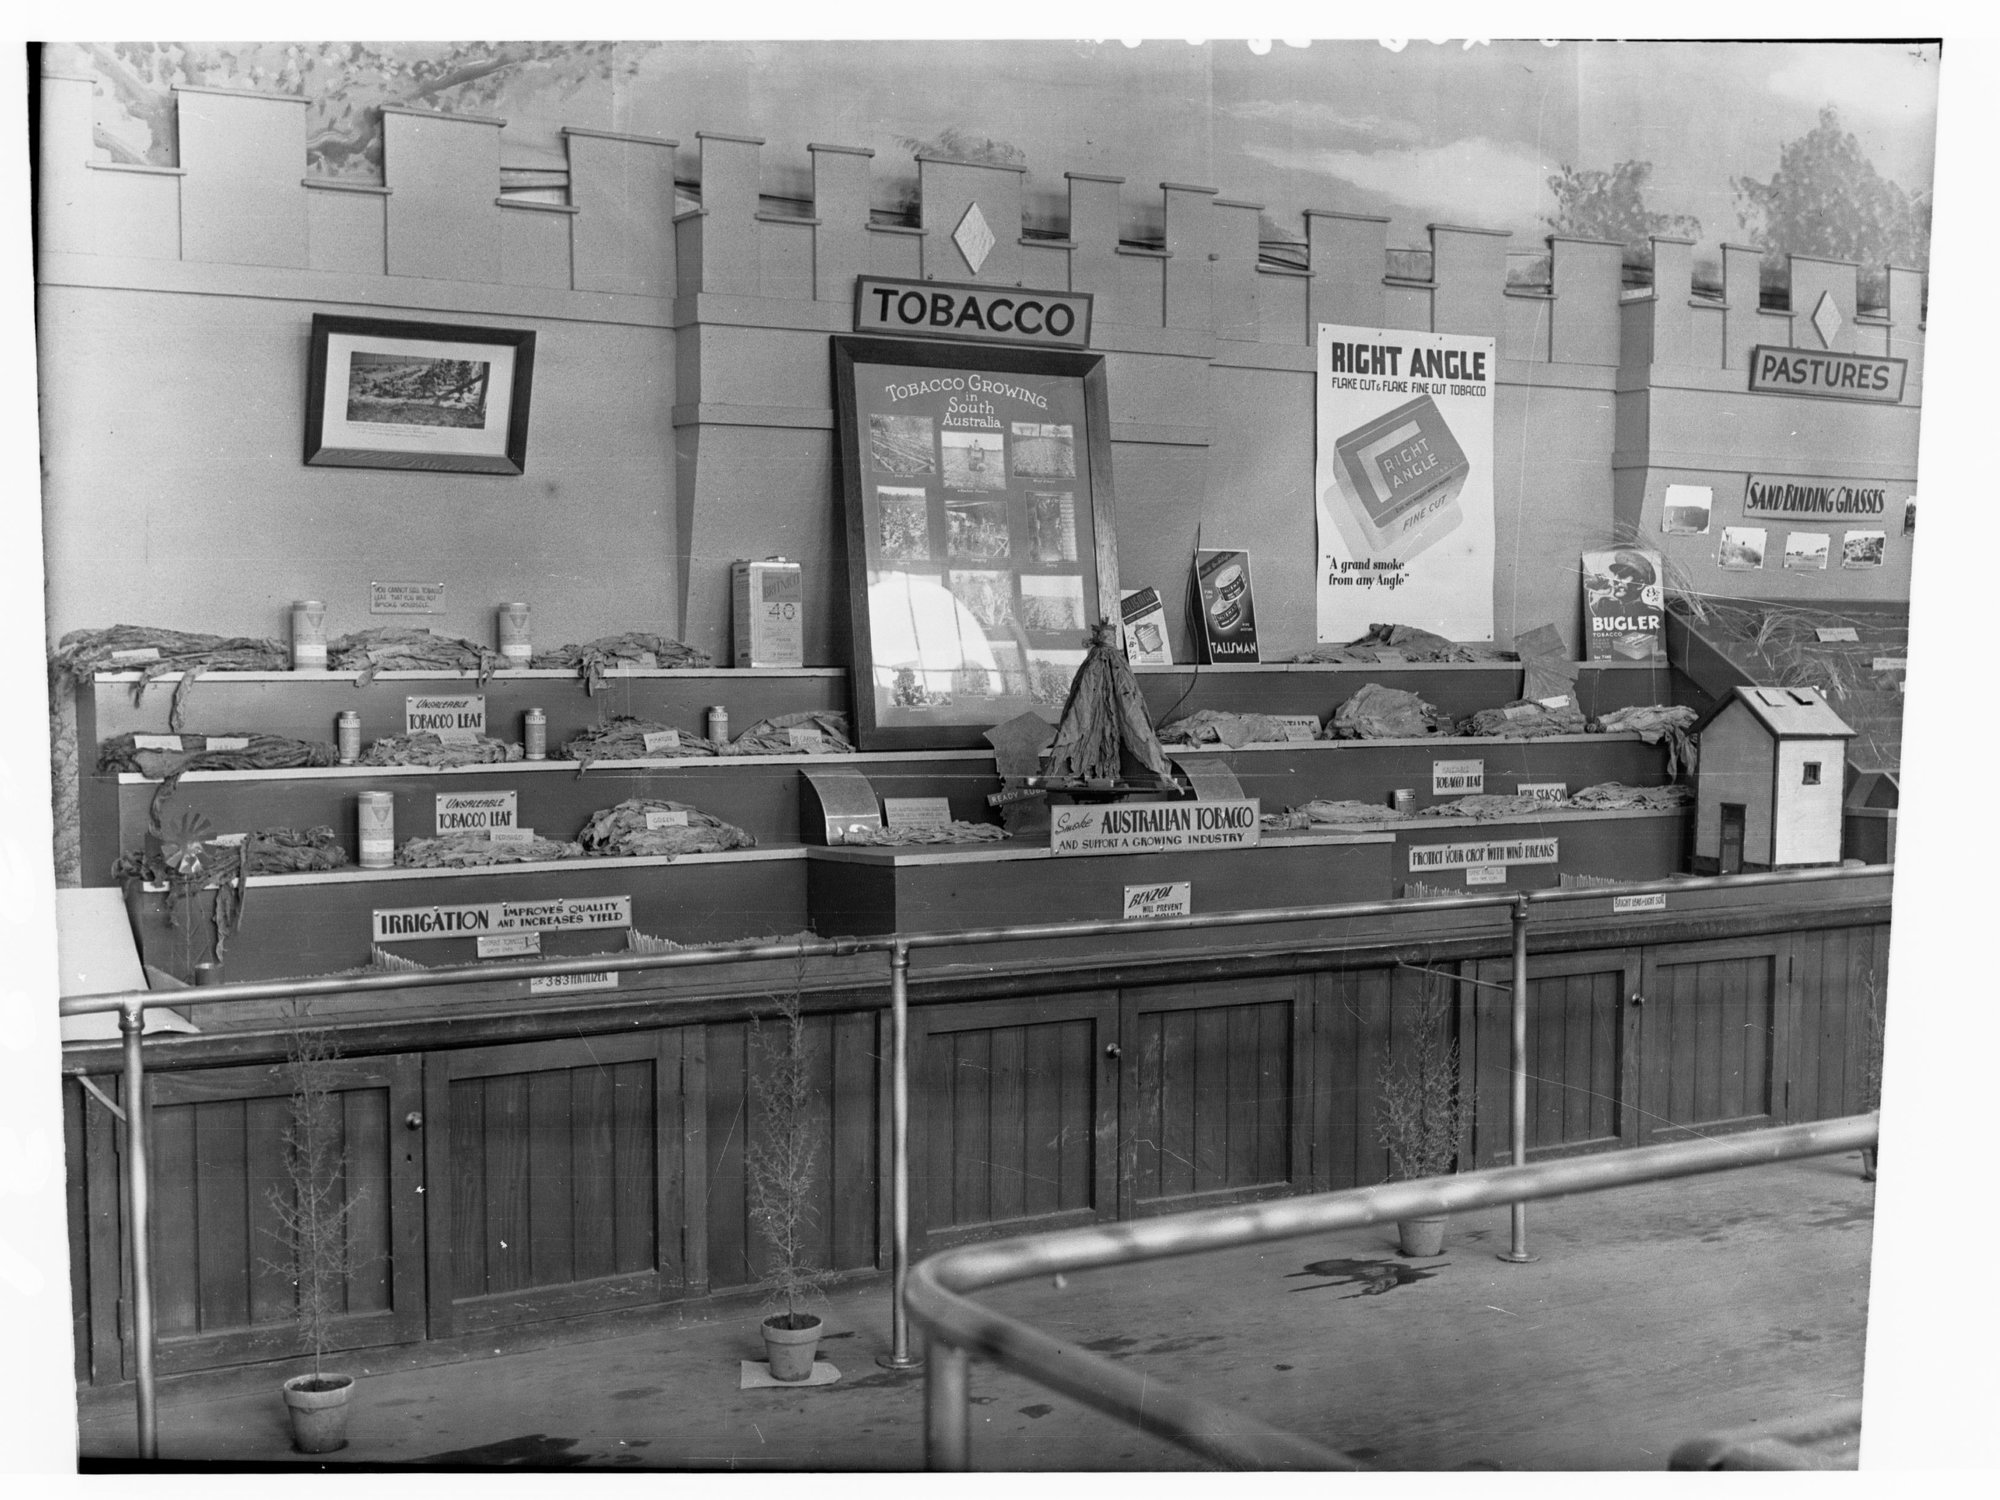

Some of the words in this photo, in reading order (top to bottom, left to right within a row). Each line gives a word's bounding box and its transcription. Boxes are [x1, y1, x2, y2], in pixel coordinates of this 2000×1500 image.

[872, 287, 1075, 337] TOBACCO
[1332, 342, 1403, 376] RIGHT
[1409, 348, 1486, 381] ANGLE
[1761, 355, 1890, 391] PASTURES
[885, 377, 965, 402] TOBACCO
[1332, 377, 1358, 390] FLAKE
[1382, 381, 1408, 393] FLAKE
[1411, 382, 1429, 394] FINE
[1432, 383, 1447, 395] CUT
[1450, 384, 1487, 397] TOBACCO
[965, 391, 978, 402] in
[948, 396, 995, 415] South
[1383, 438, 1430, 473] RIGHT
[1392, 453, 1439, 488] ANGLE
[1835, 486, 1886, 514] GRASSES
[1402, 507, 1427, 532] FINE
[1428, 494, 1448, 513] CUT
[1341, 558, 1371, 573] grand
[1373, 558, 1405, 570] smoke
[1328, 573, 1353, 586] from
[1355, 576, 1375, 589] any
[768, 603, 796, 620] 40
[1592, 615, 1660, 631] BUGLER
[1211, 641, 1257, 654] TALISMAN
[416, 699, 470, 709] UNSALEABLE
[409, 713, 454, 729] TOBACCO
[458, 712, 482, 728] LEAF
[1435, 776, 1464, 789] TOBACCO
[1466, 775, 1482, 788] LEAF
[445, 798, 506, 809] UNSALEABLE
[990, 791, 1018, 803] READY
[1536, 788, 1567, 802] SEASON
[439, 812, 487, 829] TOBACCO
[490, 811, 513, 827] LEAF
[1055, 812, 1094, 835] Smoke
[1101, 808, 1191, 835] AUSTRALIAN
[1195, 807, 1254, 830] TOBACCO
[1058, 840, 1079, 850] AND
[1082, 837, 1118, 849] SUPPORT
[1121, 838, 1129, 848] A
[1132, 835, 1182, 847] GROWING
[1188, 833, 1245, 844] INDUSTRY
[1412, 851, 1443, 867] PROTECT
[1445, 850, 1464, 864] YOUR
[1465, 849, 1486, 863] CROP
[1487, 847, 1505, 861] WITH
[1506, 846, 1524, 860] WIND
[1525, 843, 1555, 858] BREAKS
[1128, 885, 1174, 909] BENZOL
[1142, 904, 1154, 913] WILL
[1156, 902, 1183, 912] PREVENT
[381, 910, 490, 935] IRRIGATION
[503, 904, 564, 917] IMPROVES
[568, 902, 619, 913] QUALITY
[497, 919, 515, 928] AND
[520, 914, 584, 927] INCREASES
[588, 912, 623, 923] YIELD
[546, 974, 569, 987] 383
